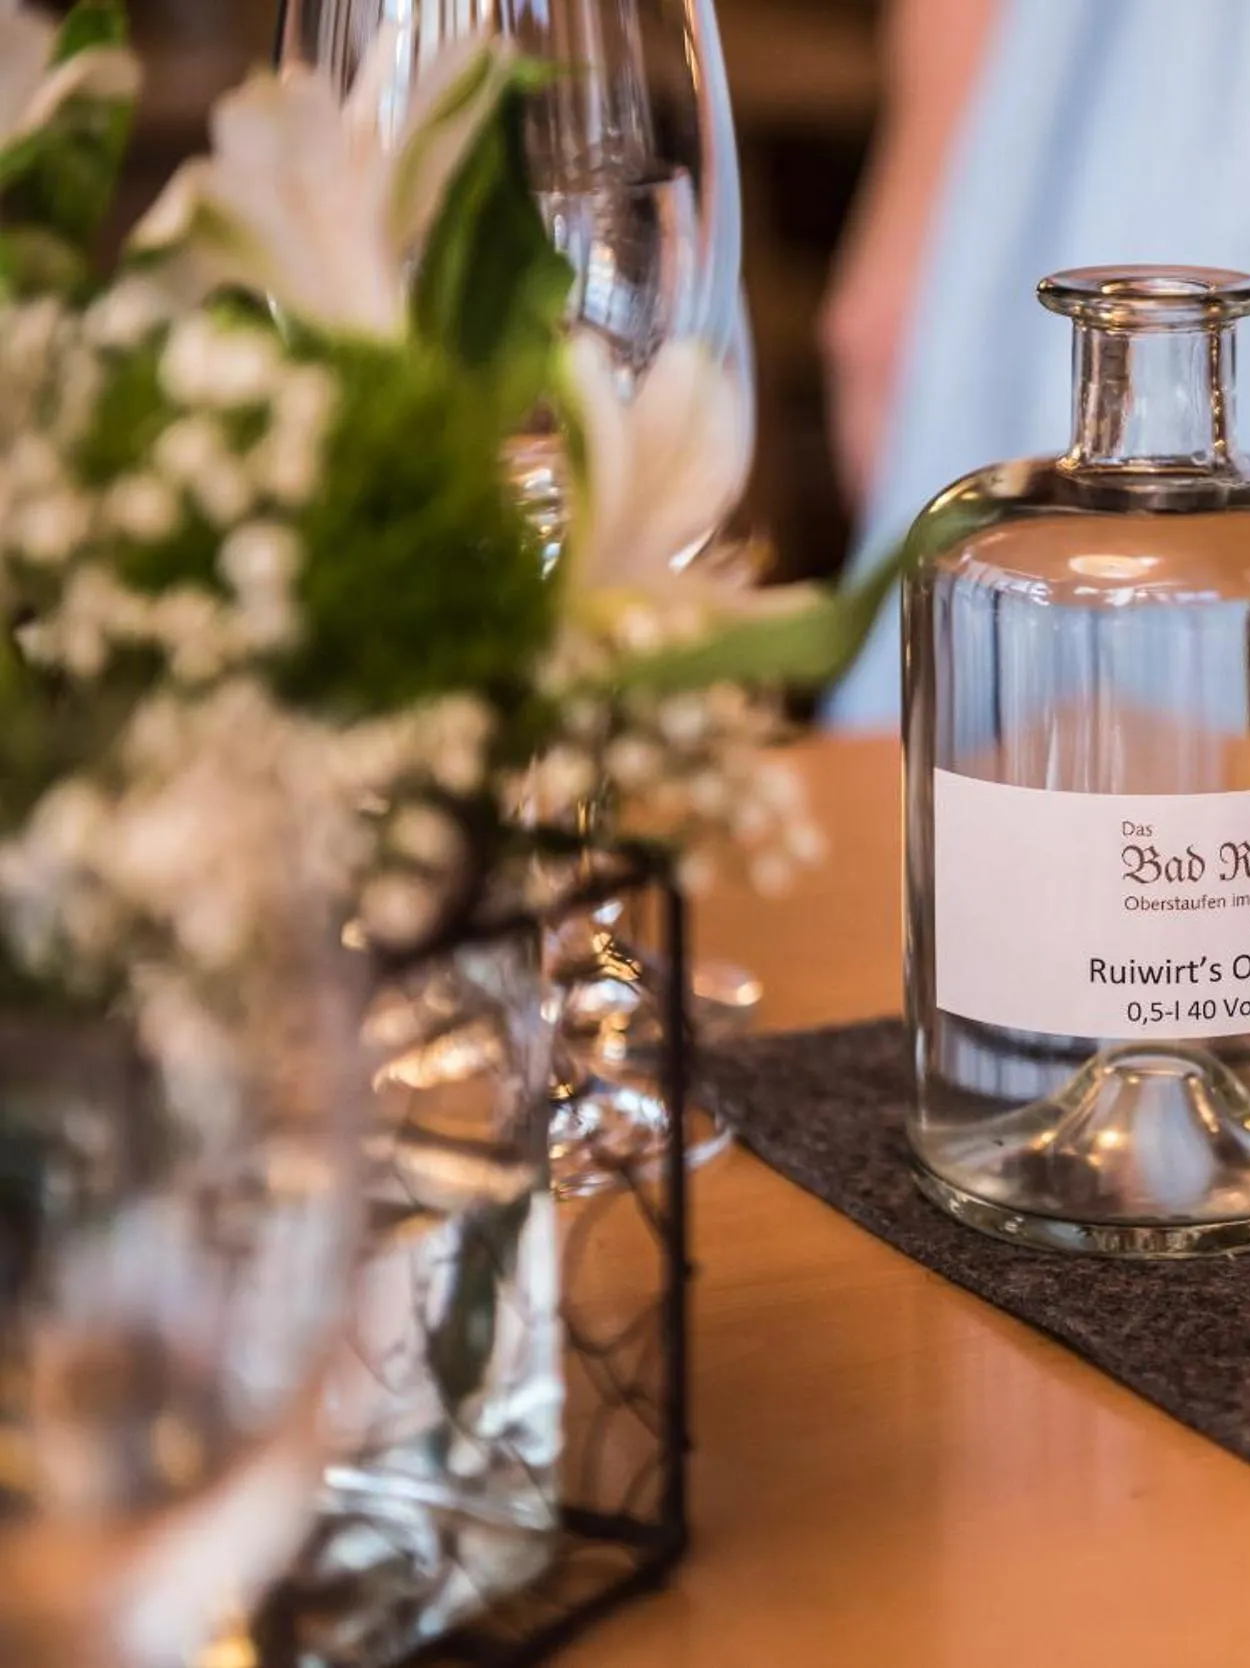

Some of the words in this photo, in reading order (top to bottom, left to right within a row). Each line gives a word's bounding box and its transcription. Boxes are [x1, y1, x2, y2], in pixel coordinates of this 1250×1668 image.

[1121, 820, 1153, 837] Das
[1121, 844, 1206, 884] Bad
[1124, 894, 1226, 912] Oberstaufen
[1232, 893, 1250, 907] im
[1090, 956, 1222, 985] Ruiwirt’s
[1187, 999, 1217, 1020] 40
